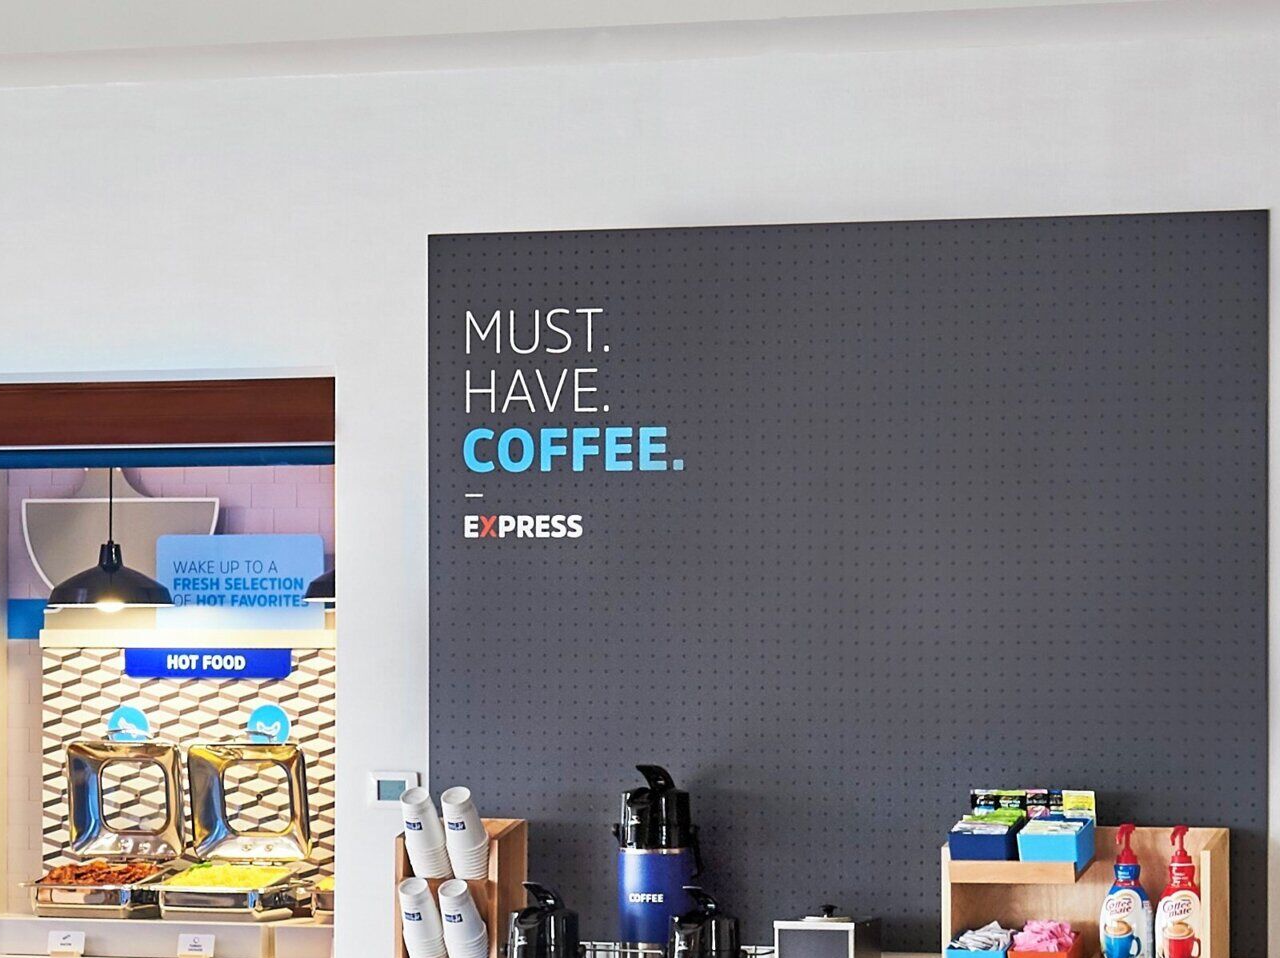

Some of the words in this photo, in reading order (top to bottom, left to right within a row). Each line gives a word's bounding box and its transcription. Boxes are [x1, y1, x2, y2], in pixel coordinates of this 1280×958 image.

[464, 307, 610, 355] MUST.
[464, 367, 610, 414] HAVE.
[462, 425, 685, 474] COFFEE.
[463, 513, 584, 539] EXPRESS
[173, 560, 215, 574] WAKE
[220, 560, 240, 574] UP
[245, 560, 263, 574] TO
[268, 560, 278, 574] A
[173, 577, 220, 591] FRESH
[224, 577, 304, 591] SELECTION
[173, 594, 191, 607] OF
[196, 594, 226, 607] HOT
[166, 654, 199, 670] HOT
[202, 655, 246, 670] FOOD
[628, 893, 664, 903] COFFEE
